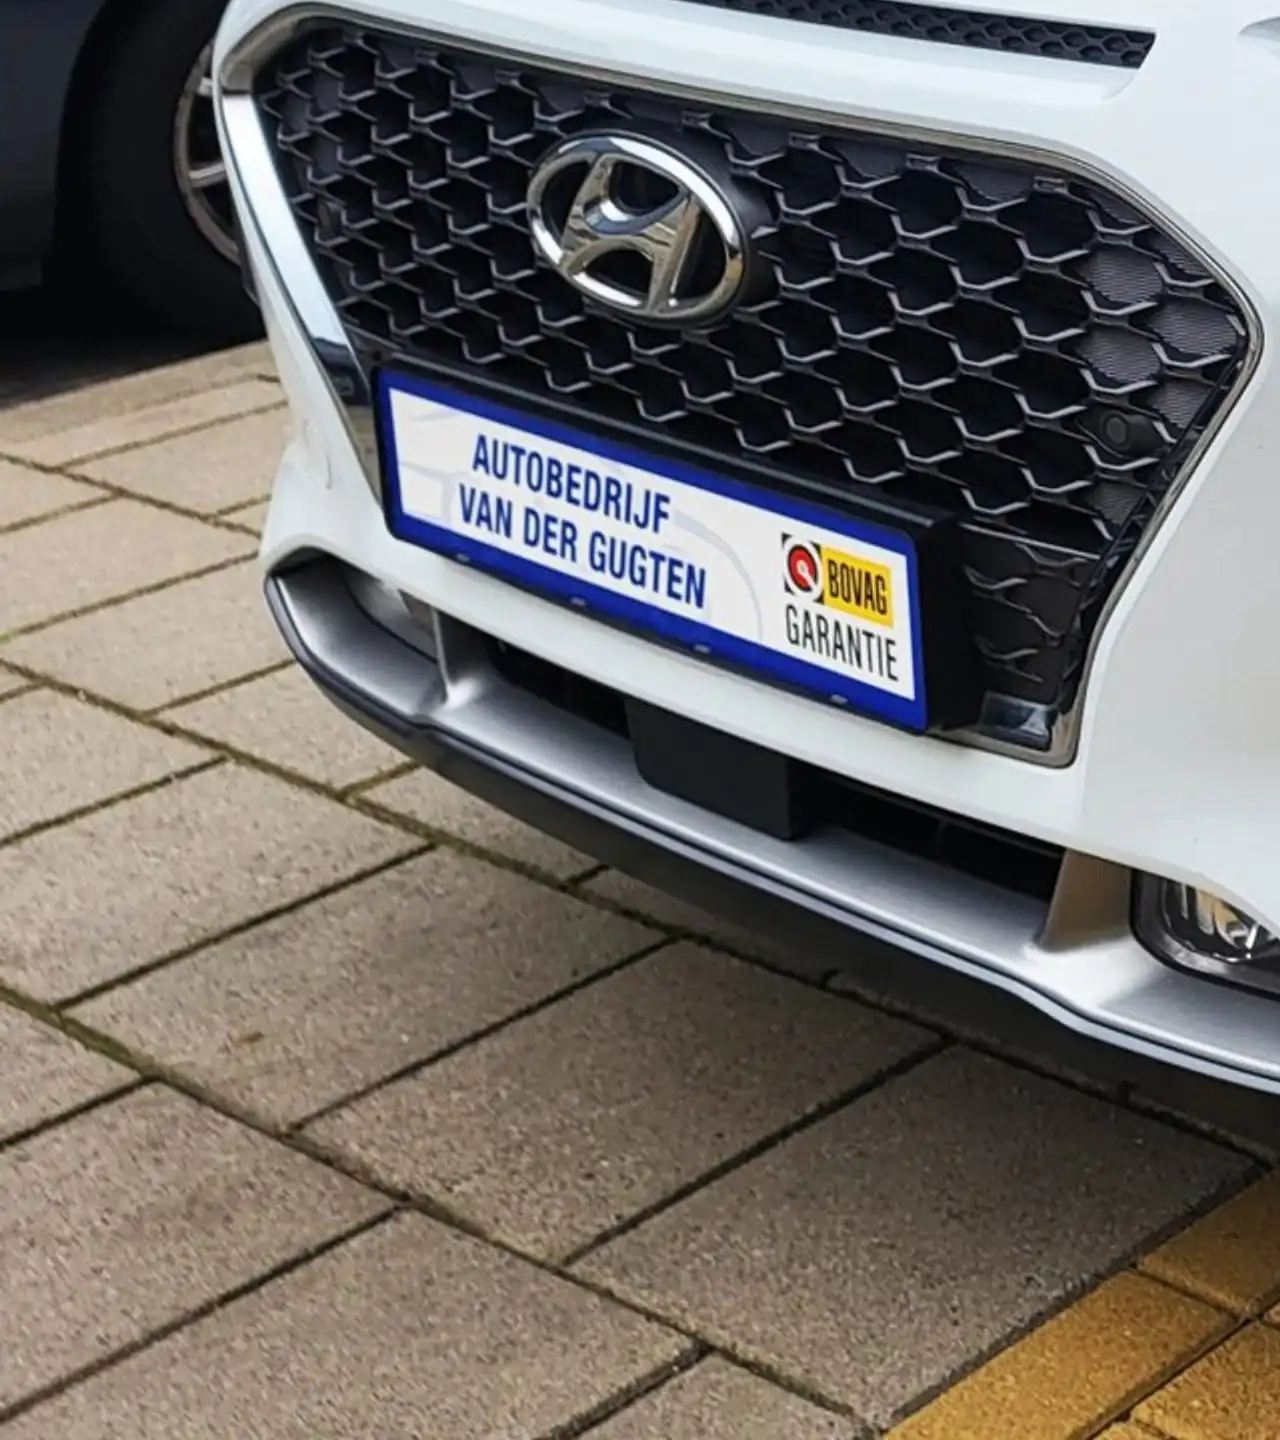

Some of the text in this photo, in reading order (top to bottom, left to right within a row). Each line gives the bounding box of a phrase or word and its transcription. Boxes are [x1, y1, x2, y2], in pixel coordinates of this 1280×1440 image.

[472, 434, 670, 533] AUTOBEDRIJF
[458, 483, 706, 609] VAN DER GUGTEN
[827, 558, 888, 616] BOVAG
[786, 605, 898, 682] GARANTIE
